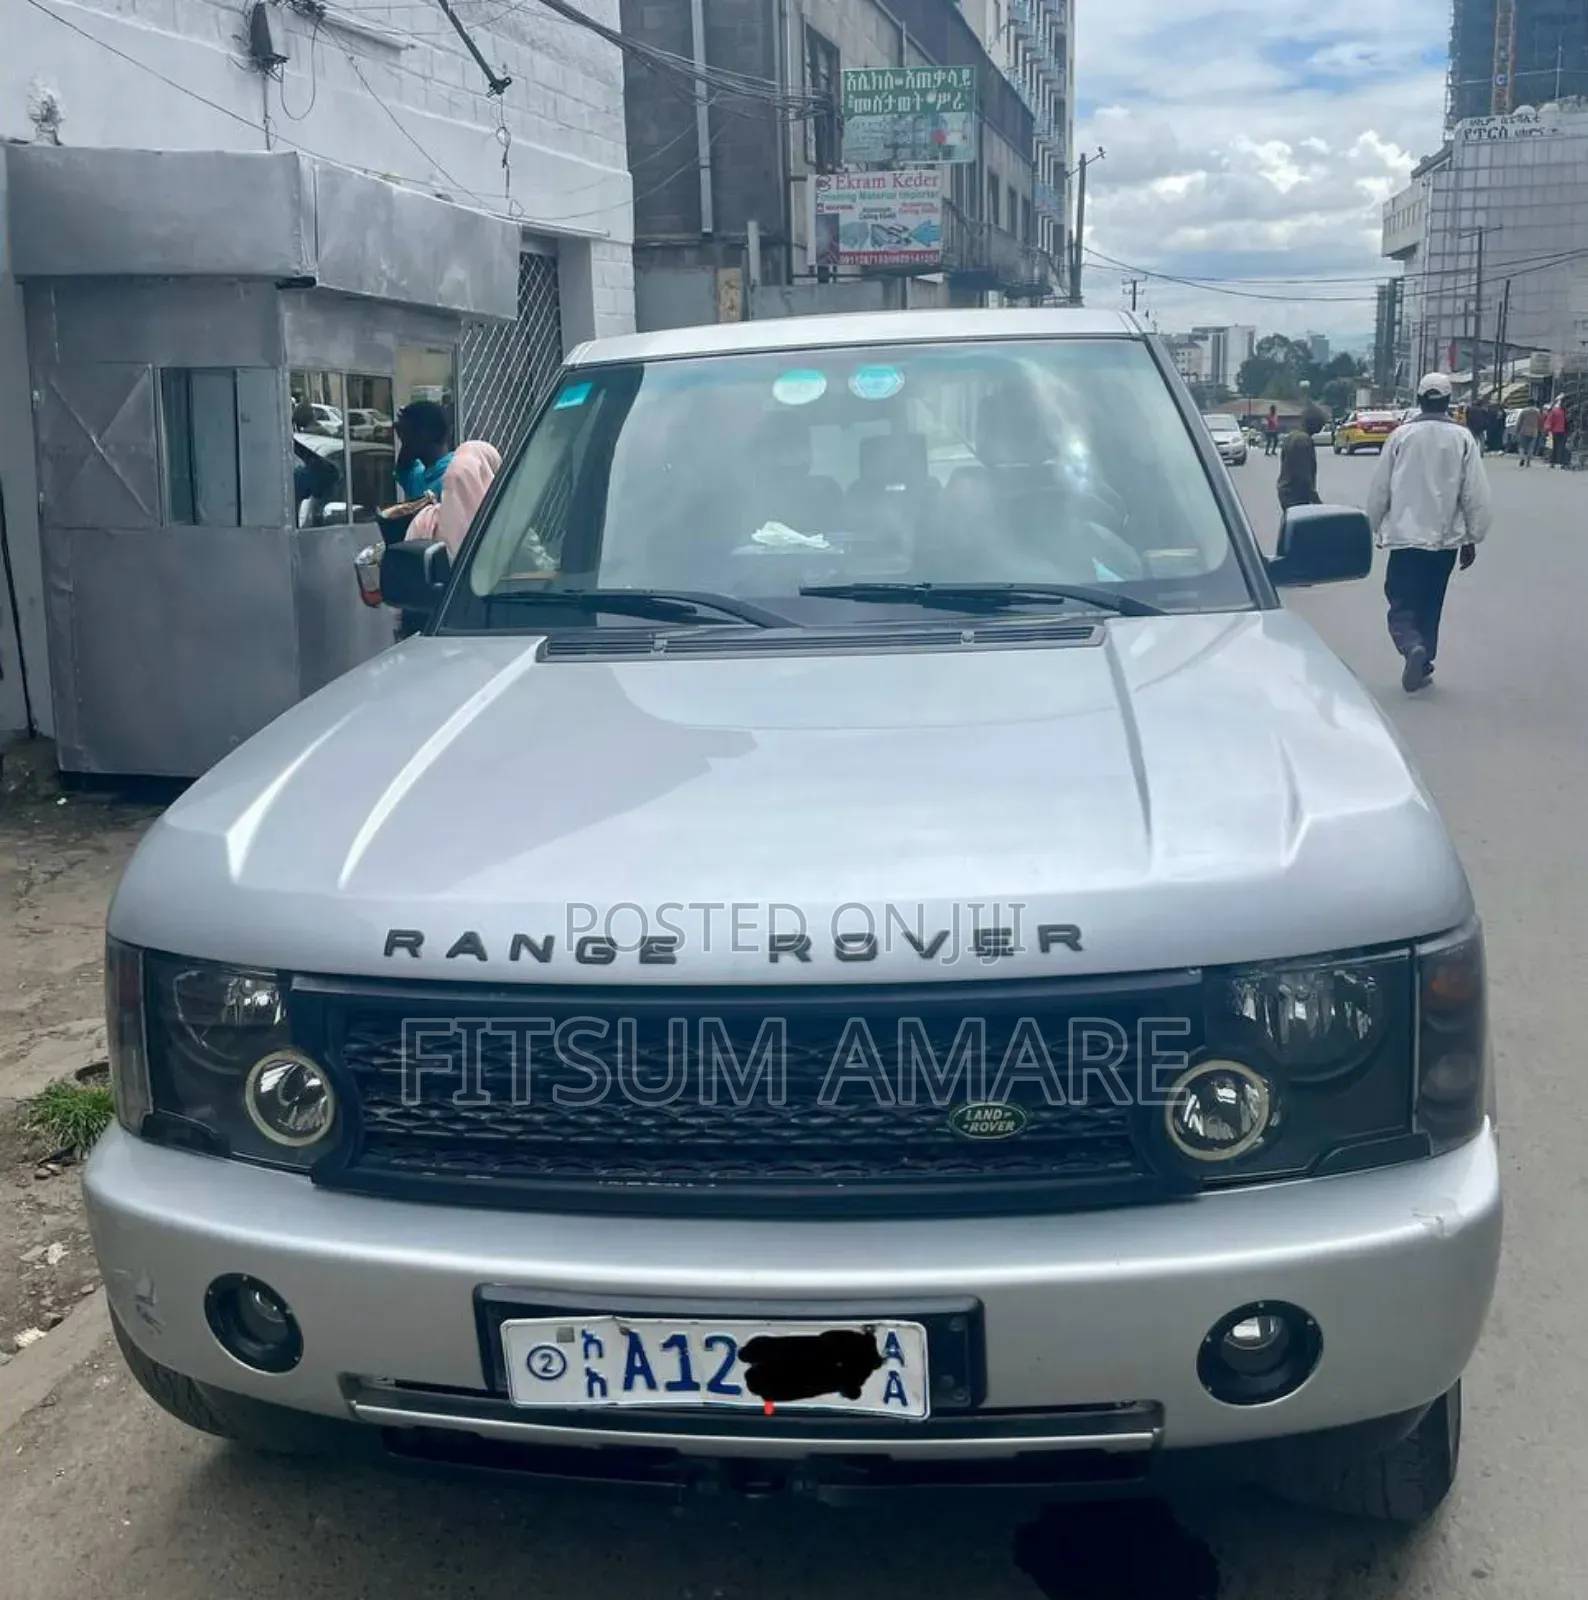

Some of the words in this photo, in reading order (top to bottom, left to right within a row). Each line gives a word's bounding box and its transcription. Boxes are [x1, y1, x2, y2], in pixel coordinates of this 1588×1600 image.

[836, 173, 886, 190] Ekram
[383, 928, 679, 965] RANGE
[768, 923, 1085, 963] ROVER
[965, 1108, 1003, 1121] LAND
[968, 1120, 1016, 1133] ROVER
